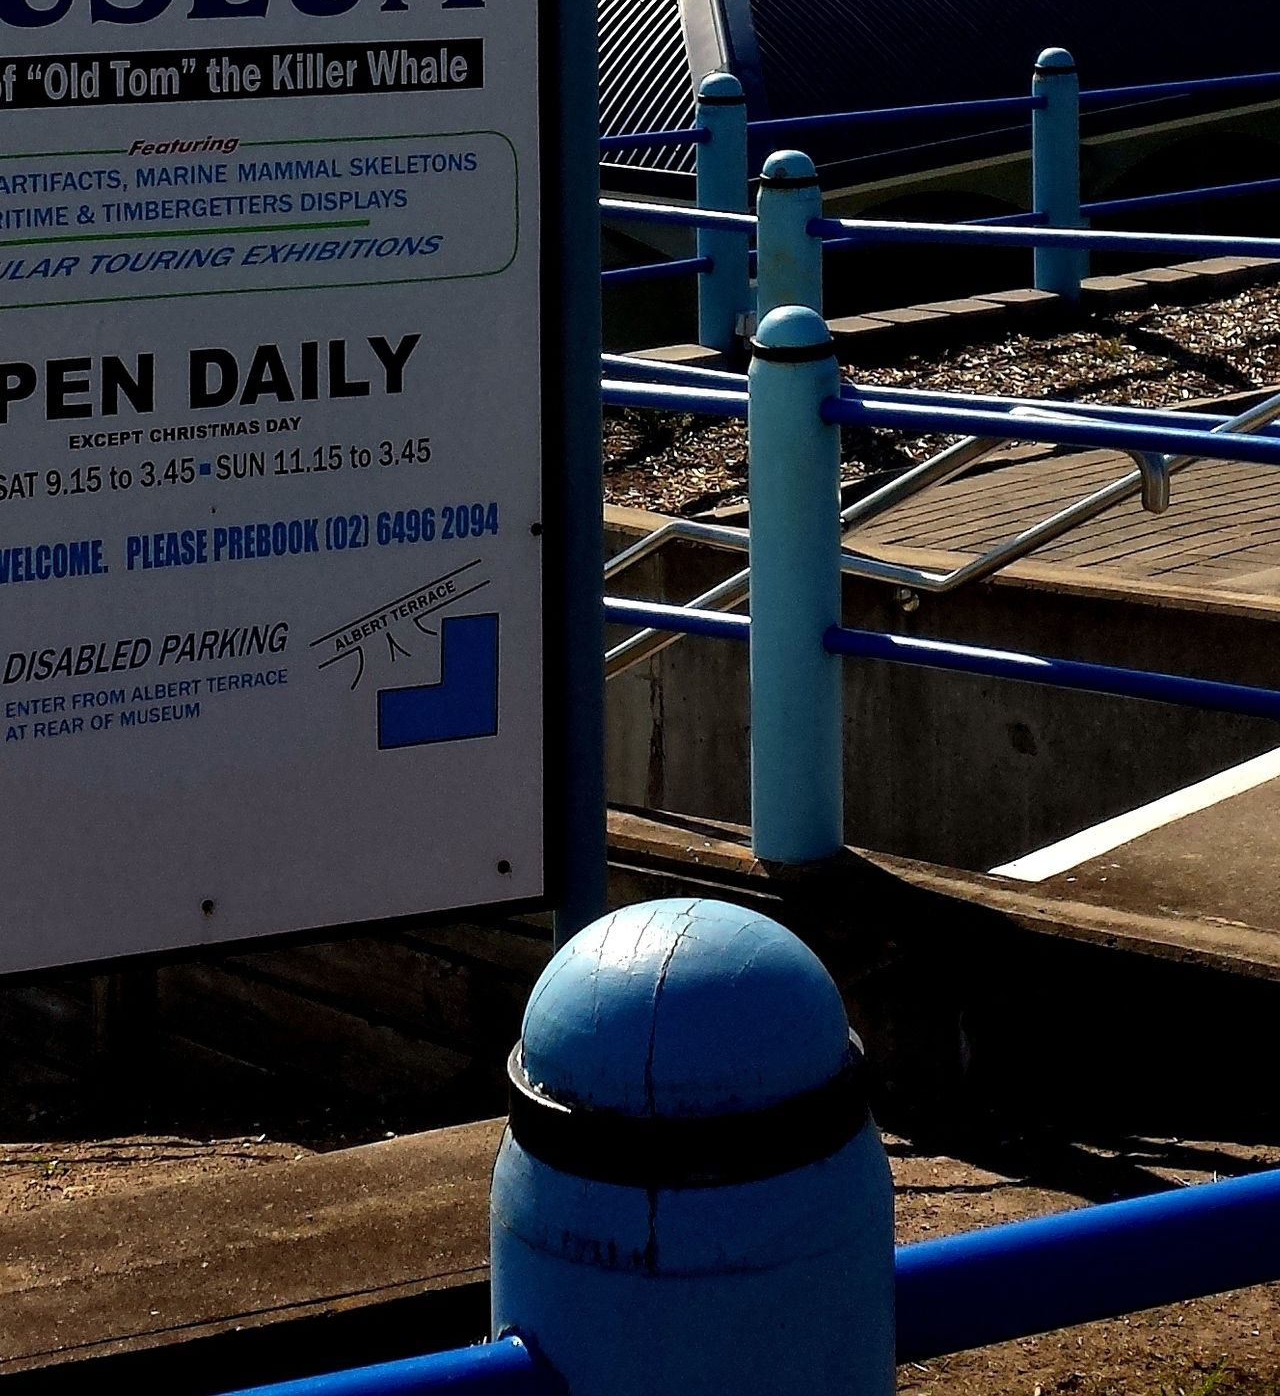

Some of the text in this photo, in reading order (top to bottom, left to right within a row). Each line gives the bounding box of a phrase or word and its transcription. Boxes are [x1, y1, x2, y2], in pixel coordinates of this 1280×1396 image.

[206, 56, 262, 92] the
[272, 52, 358, 91] Killer
[366, 47, 469, 86] Whale
[128, 135, 240, 156] Featuring
[135, 163, 228, 190] MARINE
[238, 158, 342, 184] MAMMAL
[349, 152, 478, 178] SKELETONS
[76, 204, 96, 225] &
[102, 193, 293, 223] TIMBERGETTERS
[300, 188, 409, 213] DISPLAYS
[88, 246, 236, 276] TOURING
[239, 234, 445, 267] EXHIBITIONS
[187, 334, 422, 410] DAILY
[68, 416, 302, 449] EXCEPT CHRISTMAS DAY
[45, 466, 102, 497] 9.15
[110, 466, 133, 490] to
[139, 457, 196, 486] 3.45
[215, 452, 266, 480] SUN
[273, 445, 343, 475] 11.15
[350, 445, 372, 469] to
[378, 438, 432, 467] 3.45
[126, 529, 209, 571] PLEASE
[213, 518, 320, 562] PREBOOK
[325, 514, 370, 552] (02)
[376, 507, 436, 546] 6496
[440, 502, 500, 541] 2094
[334, 579, 458, 652] ALBERT TERRACE
[2, 622, 290, 685] DISABLED PARKING
[5, 668, 289, 718] ENTER FROM ALBERT TERRACE
[5, 702, 201, 742] AT REAR OF MUSEUM
